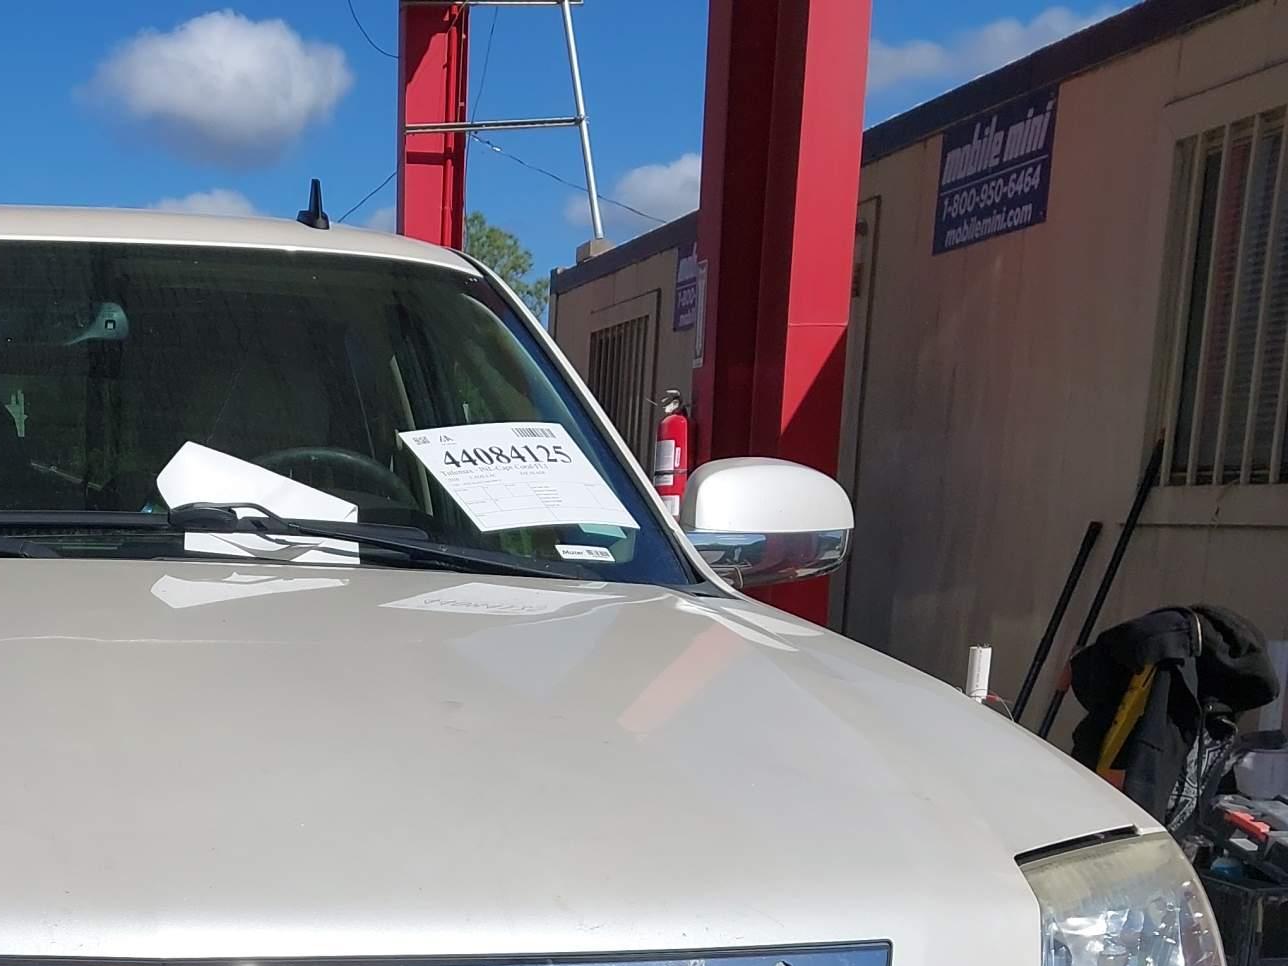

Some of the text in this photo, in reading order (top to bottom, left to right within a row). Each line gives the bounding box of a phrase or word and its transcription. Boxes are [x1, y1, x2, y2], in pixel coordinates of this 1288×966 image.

[941, 100, 1055, 186] mobile mini
[942, 164, 1041, 222] 1-800-950-6464
[944, 203, 1032, 248] mobilemini.com
[443, 445, 572, 468] 44084125
